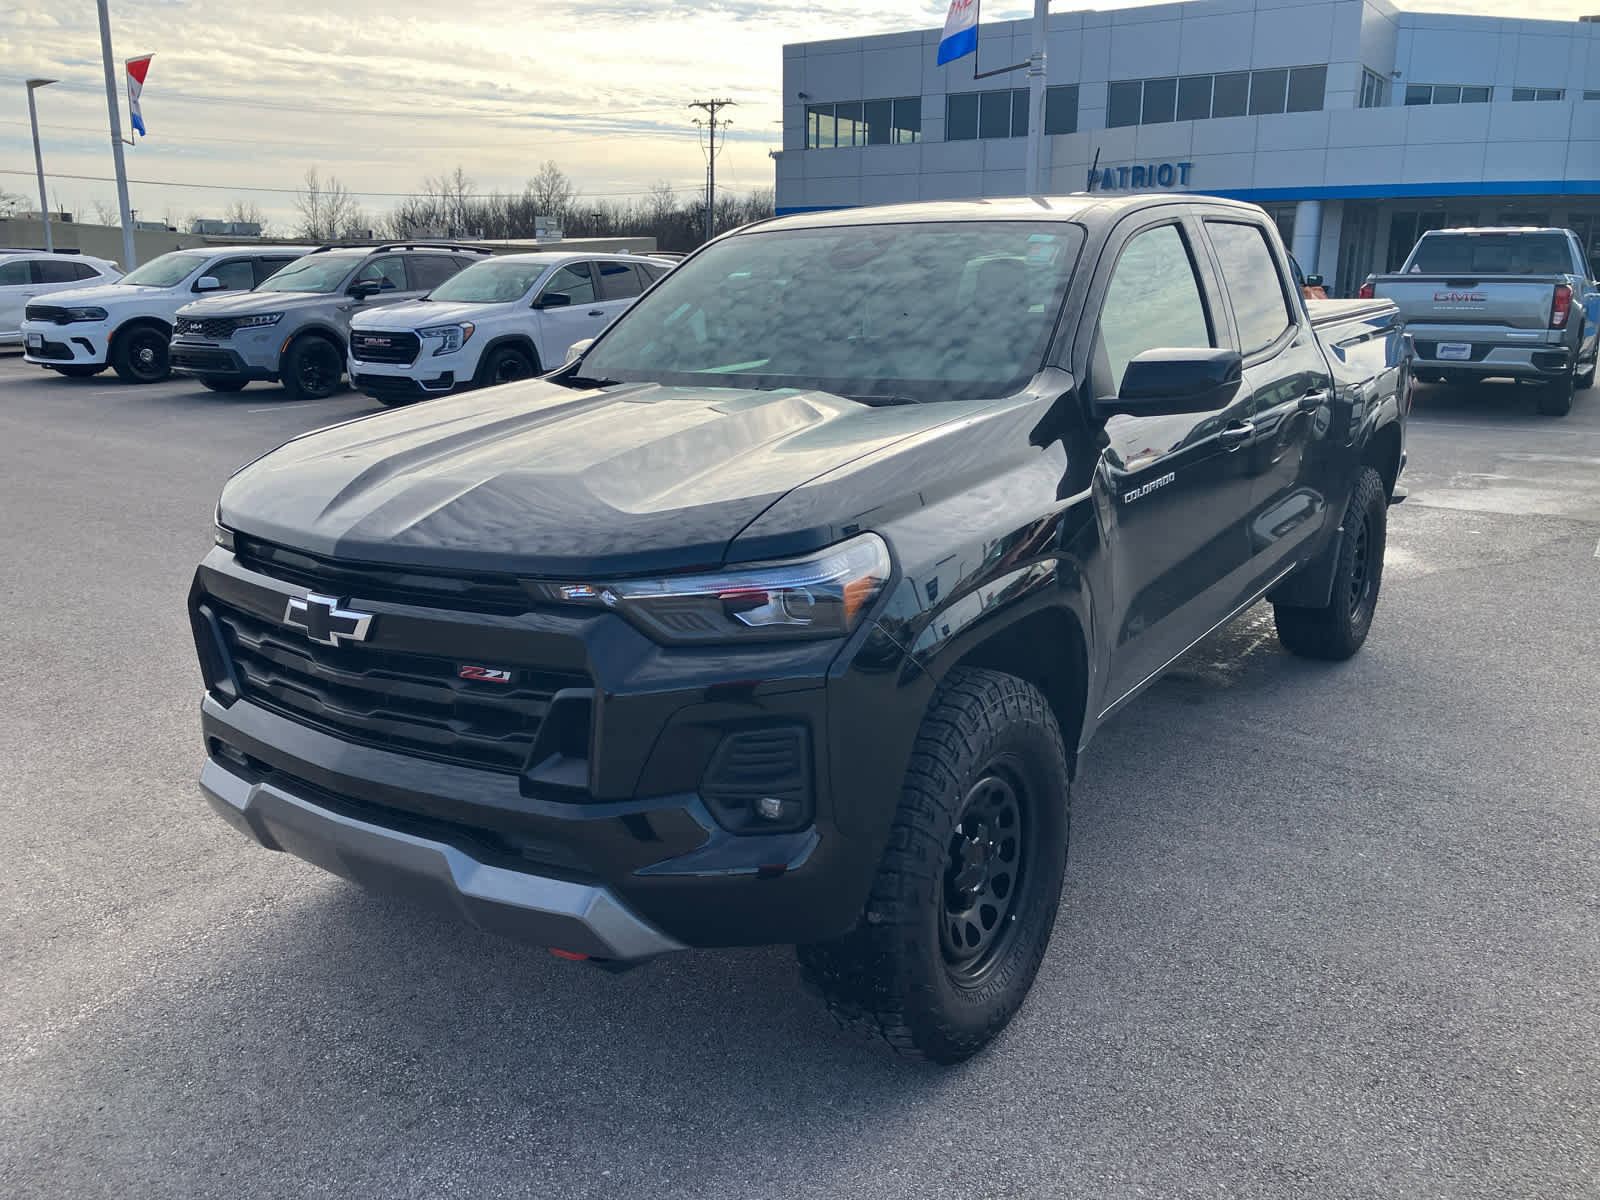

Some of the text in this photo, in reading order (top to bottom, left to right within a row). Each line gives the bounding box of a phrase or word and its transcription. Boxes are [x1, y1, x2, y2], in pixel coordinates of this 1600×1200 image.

[1087, 162, 1193, 190] PATRIOT
[1433, 291, 1488, 302] GMC
[1124, 472, 1175, 504] COLORADO
[459, 665, 511, 683] Z71
